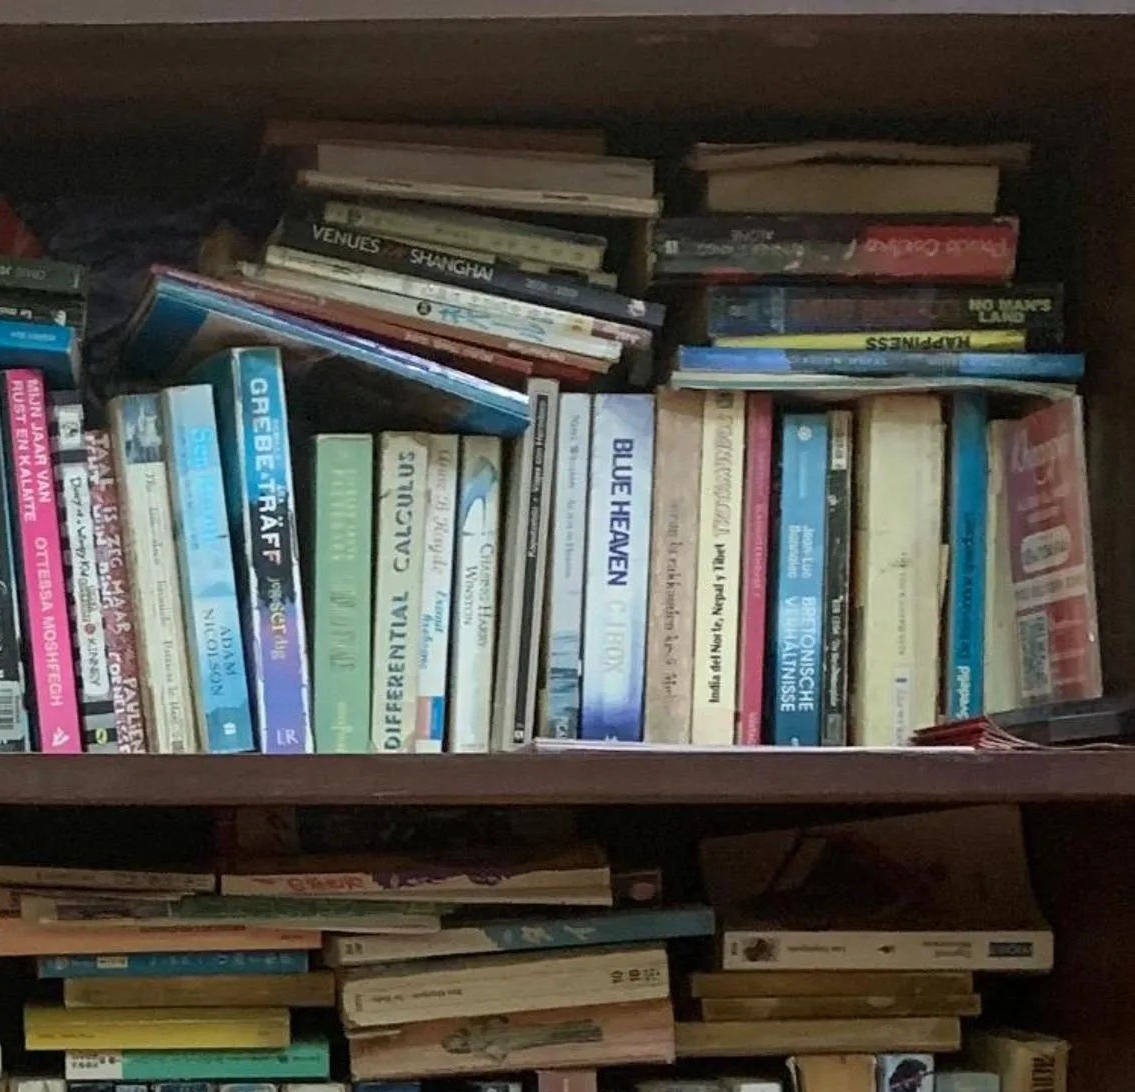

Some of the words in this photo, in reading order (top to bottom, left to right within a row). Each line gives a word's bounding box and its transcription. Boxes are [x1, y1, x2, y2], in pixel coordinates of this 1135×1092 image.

[312, 224, 381, 254] VENUES
[409, 248, 495, 282] SHANGHAI
[866, 335, 971, 351] HAPPINESS
[11, 379, 28, 425] RUST
[26, 378, 44, 418] MIJN
[249, 377, 273, 472] GREBE
[15, 429, 30, 451] EN
[29, 422, 47, 467] JAAR
[610, 437, 634, 495] BLUE
[19, 454, 36, 522] KALMTE
[34, 470, 51, 503] VAN
[393, 450, 416, 573] CALCULUS
[607, 499, 633, 586] HEAVEN
[713, 543, 726, 572] Tibet
[33, 536, 53, 612] OTTESSA
[462, 565, 479, 626] WINSTON
[711, 583, 727, 616] Nepal
[203, 607, 224, 697] NICOLSON
[219, 625, 233, 678] ADAM
[475, 605, 493, 648] HARRY
[41, 616, 63, 707] MOSHFEGH
[86, 638, 102, 687] KINNEY
[383, 590, 409, 750] DIFFERENTIAL
[709, 654, 722, 673] del
[797, 596, 818, 712] BRETONISCHE
[708, 675, 721, 704] India
